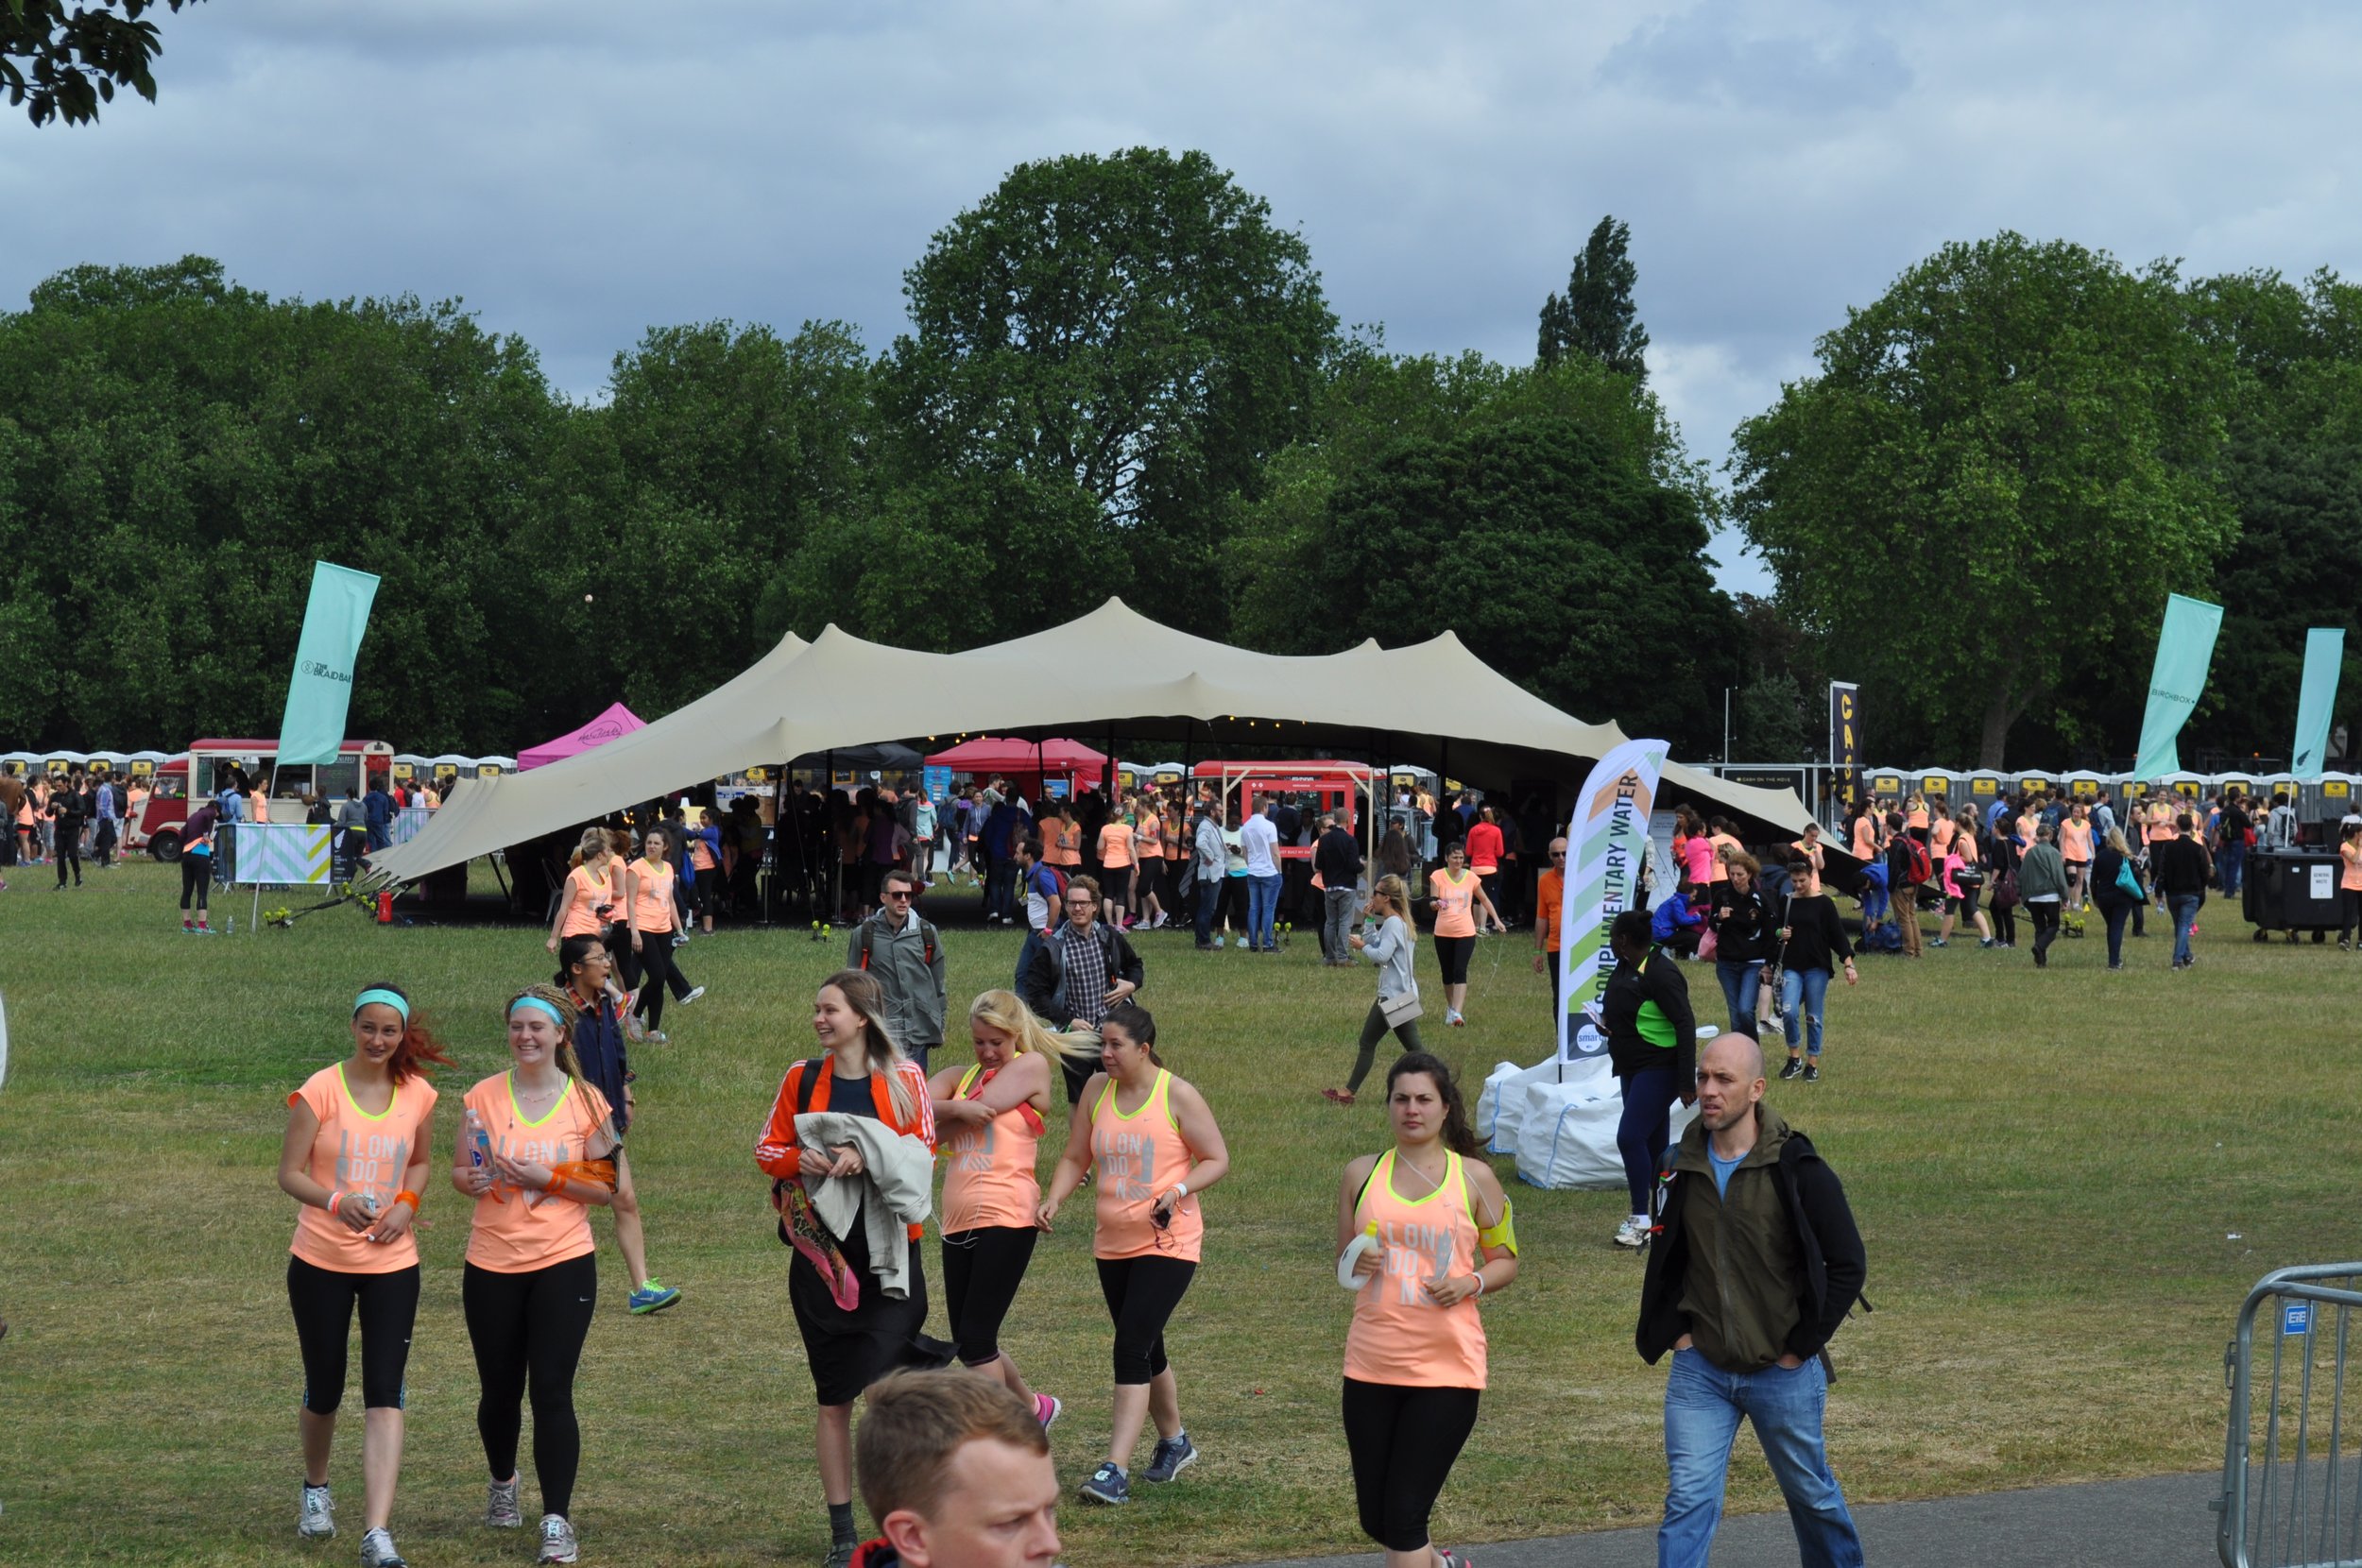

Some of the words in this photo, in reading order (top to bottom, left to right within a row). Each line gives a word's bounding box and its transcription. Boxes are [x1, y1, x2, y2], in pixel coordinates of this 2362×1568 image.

[1609, 775, 1638, 837] WATER
[352, 1133, 394, 1159] LON
[1104, 1133, 1141, 1156] LON
[351, 1158, 378, 1183] DO
[1106, 1155, 1128, 1176] DO
[1115, 1178, 1126, 1201] N
[1386, 1221, 1435, 1252] LON
[1387, 1248, 1418, 1277] DO
[1400, 1277, 1417, 1306] N
